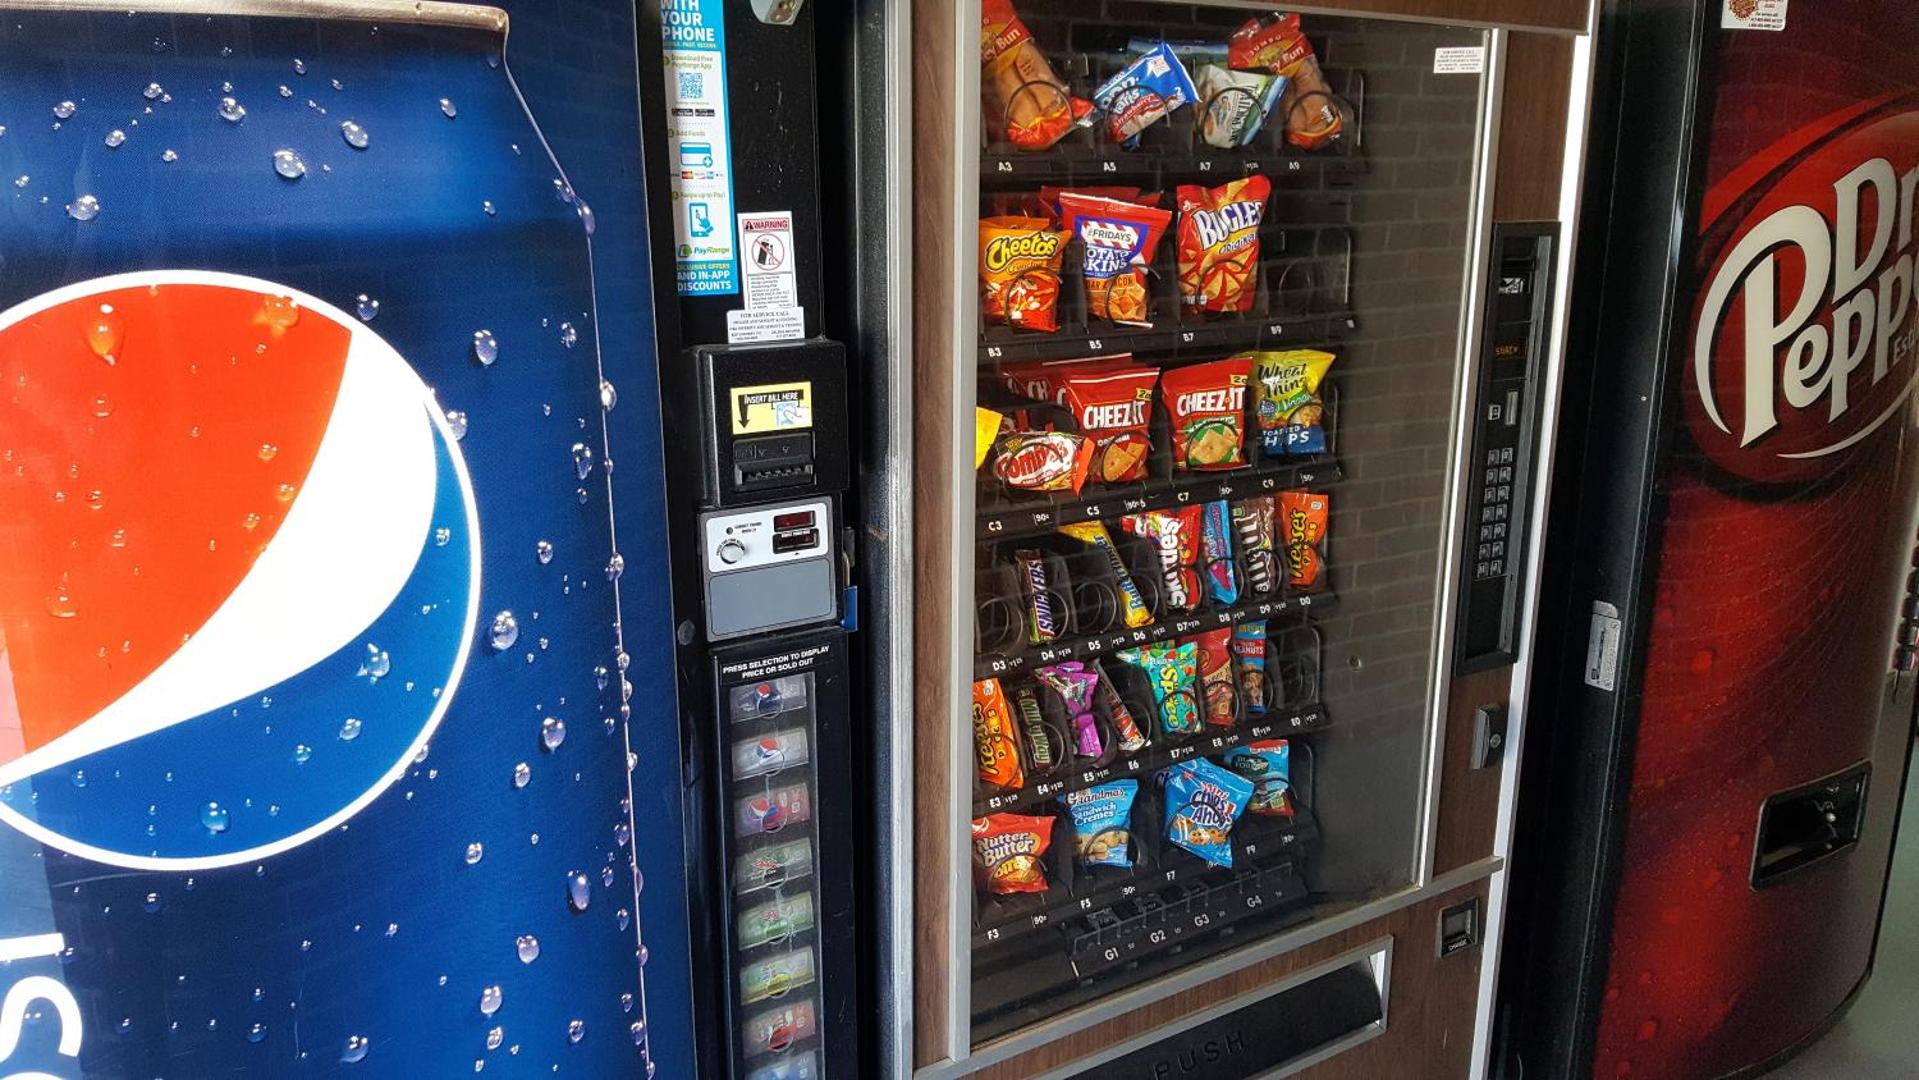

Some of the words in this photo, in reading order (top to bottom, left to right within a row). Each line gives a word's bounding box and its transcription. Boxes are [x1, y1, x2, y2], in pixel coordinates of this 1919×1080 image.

[660, 0, 699, 11] WITH
[661, 11, 703, 26] YOUR
[662, 26, 715, 42] PHONE
[995, 28, 1021, 49] Bun
[998, 162, 1013, 172] A3
[1103, 162, 1116, 172] A5
[1200, 162, 1211, 171] A7
[1289, 162, 1300, 171] A9
[754, 220, 788, 229] WARNING
[1192, 202, 1263, 251] BUGLES
[1092, 229, 1132, 241] FRIDAYS
[1833, 157, 1919, 304] Dr
[694, 246, 730, 256] PayRange
[987, 231, 1059, 270] Cheetos
[677, 270, 697, 279] AND
[698, 269, 730, 279] IN-APP
[677, 280, 732, 291] DISCOUNTS
[1183, 332, 1194, 342] B7
[1089, 340, 1102, 349] B5
[988, 347, 1002, 357] B3
[1258, 363, 1307, 382] Wheat
[744, 395, 768, 405] INSERT
[781, 392, 799, 400] HERE
[1262, 479, 1274, 488] C9
[1177, 492, 1189, 501] C7
[1086, 506, 1100, 516] C5
[988, 521, 1003, 531] C3
[1028, 558, 1056, 636] SNICKERS
[1260, 604, 1271, 614] D9
[1219, 613, 1231, 623] D8
[1177, 622, 1188, 632] D7
[1133, 631, 1146, 641] D6
[1088, 640, 1101, 651] D5
[723, 663, 748, 674] PRESS
[748, 655, 789, 668] SELECTION
[790, 652, 800, 660] TO
[801, 645, 830, 657] DISPLAY
[1041, 650, 1055, 660] D4
[742, 669, 765, 679] PRICE
[765, 666, 777, 674] OR
[777, 661, 798, 671] SOLD
[798, 657, 814, 666] OUT
[992, 660, 1007, 671] D3
[1159, 665, 1180, 731] Spee
[1212, 738, 1222, 747] E8
[1170, 748, 1180, 758] E7
[1128, 760, 1139, 770] E6
[1083, 772, 1095, 782] E5
[1037, 784, 1049, 795] E4
[1200, 781, 1229, 798] Mini
[989, 798, 1001, 808] E3
[1191, 790, 1226, 812] Chips
[977, 832, 1029, 851] Nutter
[983, 838, 1034, 868] Butter
[1246, 845, 1256, 855] F9
[1166, 870, 1176, 881] F7
[1080, 898, 1091, 909] F5
[1247, 896, 1262, 908] G4
[1194, 914, 1210, 926] G3
[987, 929, 999, 940] F3
[1150, 930, 1167, 943] G2
[1104, 948, 1119, 960] G1
[1153, 1031, 1245, 1080] PUSH
